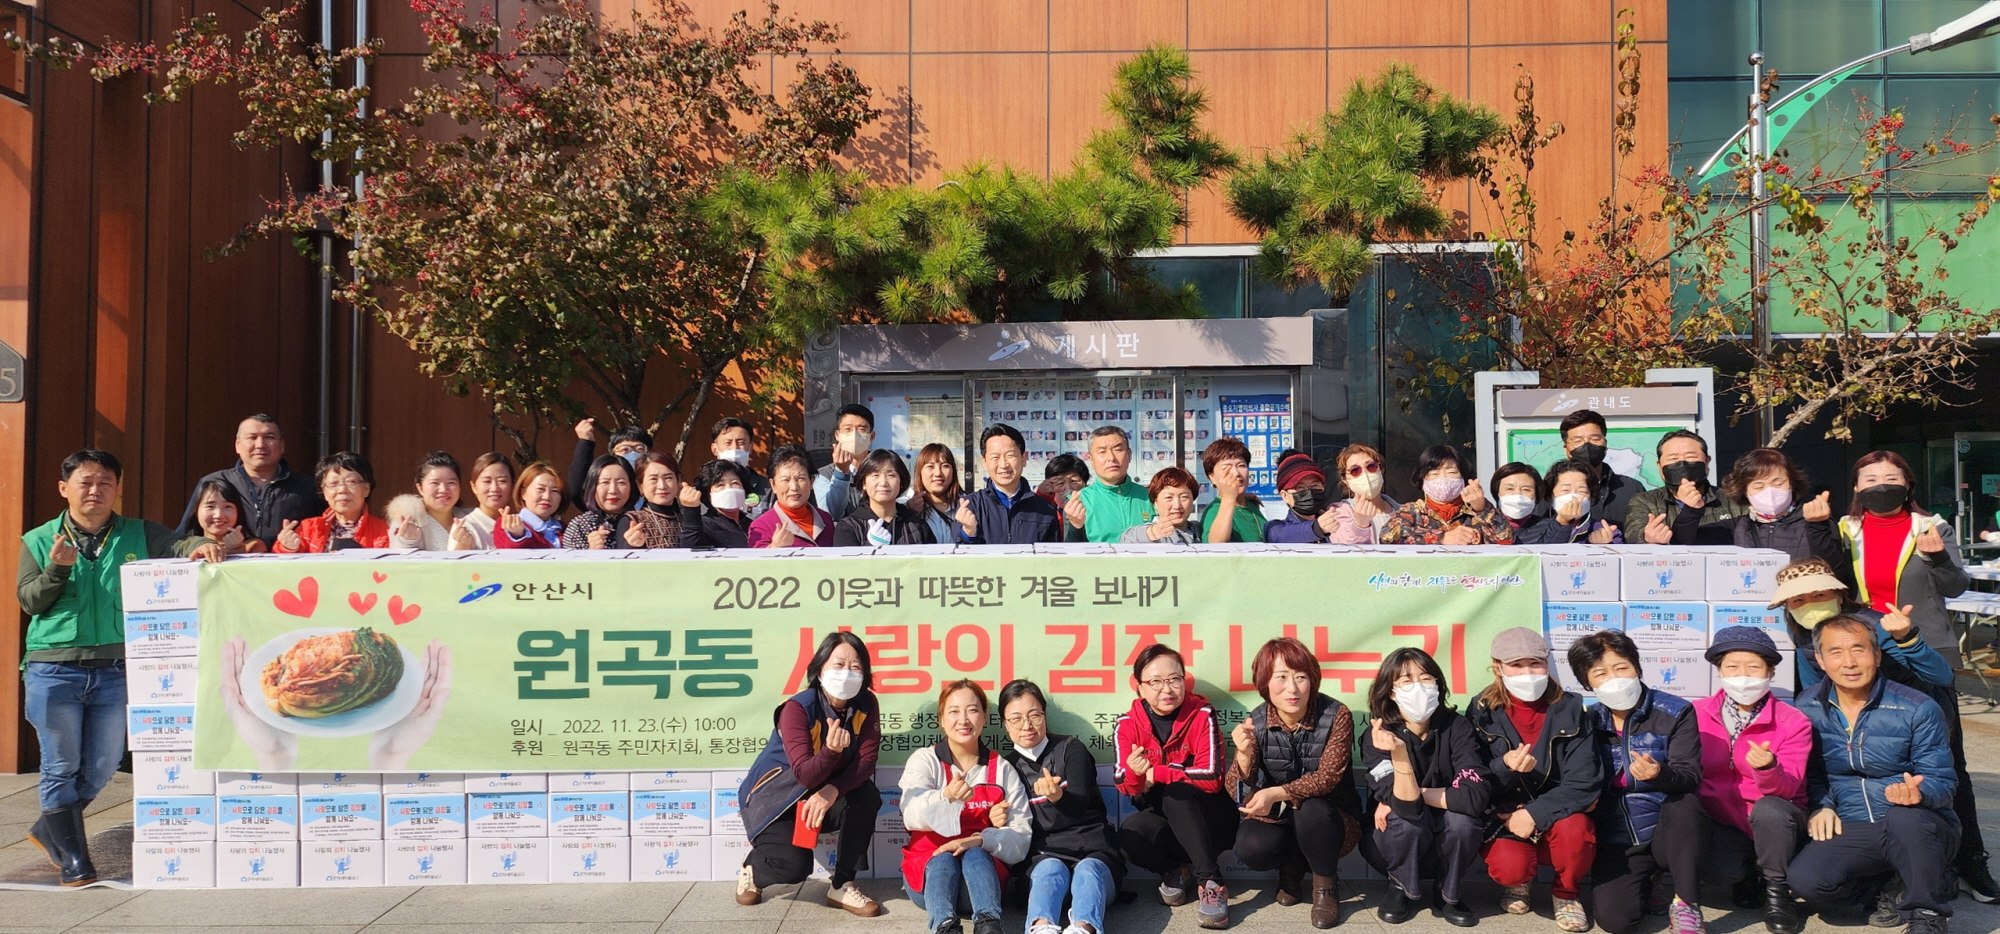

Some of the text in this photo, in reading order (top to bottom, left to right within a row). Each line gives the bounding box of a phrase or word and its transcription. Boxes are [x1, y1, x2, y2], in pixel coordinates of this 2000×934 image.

[1054, 333, 1140, 358] 게시판
[1588, 396, 1631, 409] 관내도
[512, 583, 593, 601] 안산시
[714, 575, 1180, 610] 2022 이웃과 따뜻한 겨울 보내기
[514, 629, 758, 700] 원곡동
[511, 719, 542, 735] 일시
[562, 720, 604, 734] 2022.
[612, 719, 631, 732] 11.
[638, 716, 687, 734] 23.(수)
[694, 717, 736, 732] 10:00
[879, 713, 903, 729] 곡동
[511, 740, 543, 756] 후원
[563, 740, 612, 756] 원곡동
[617, 738, 702, 755] 주민자치회,
